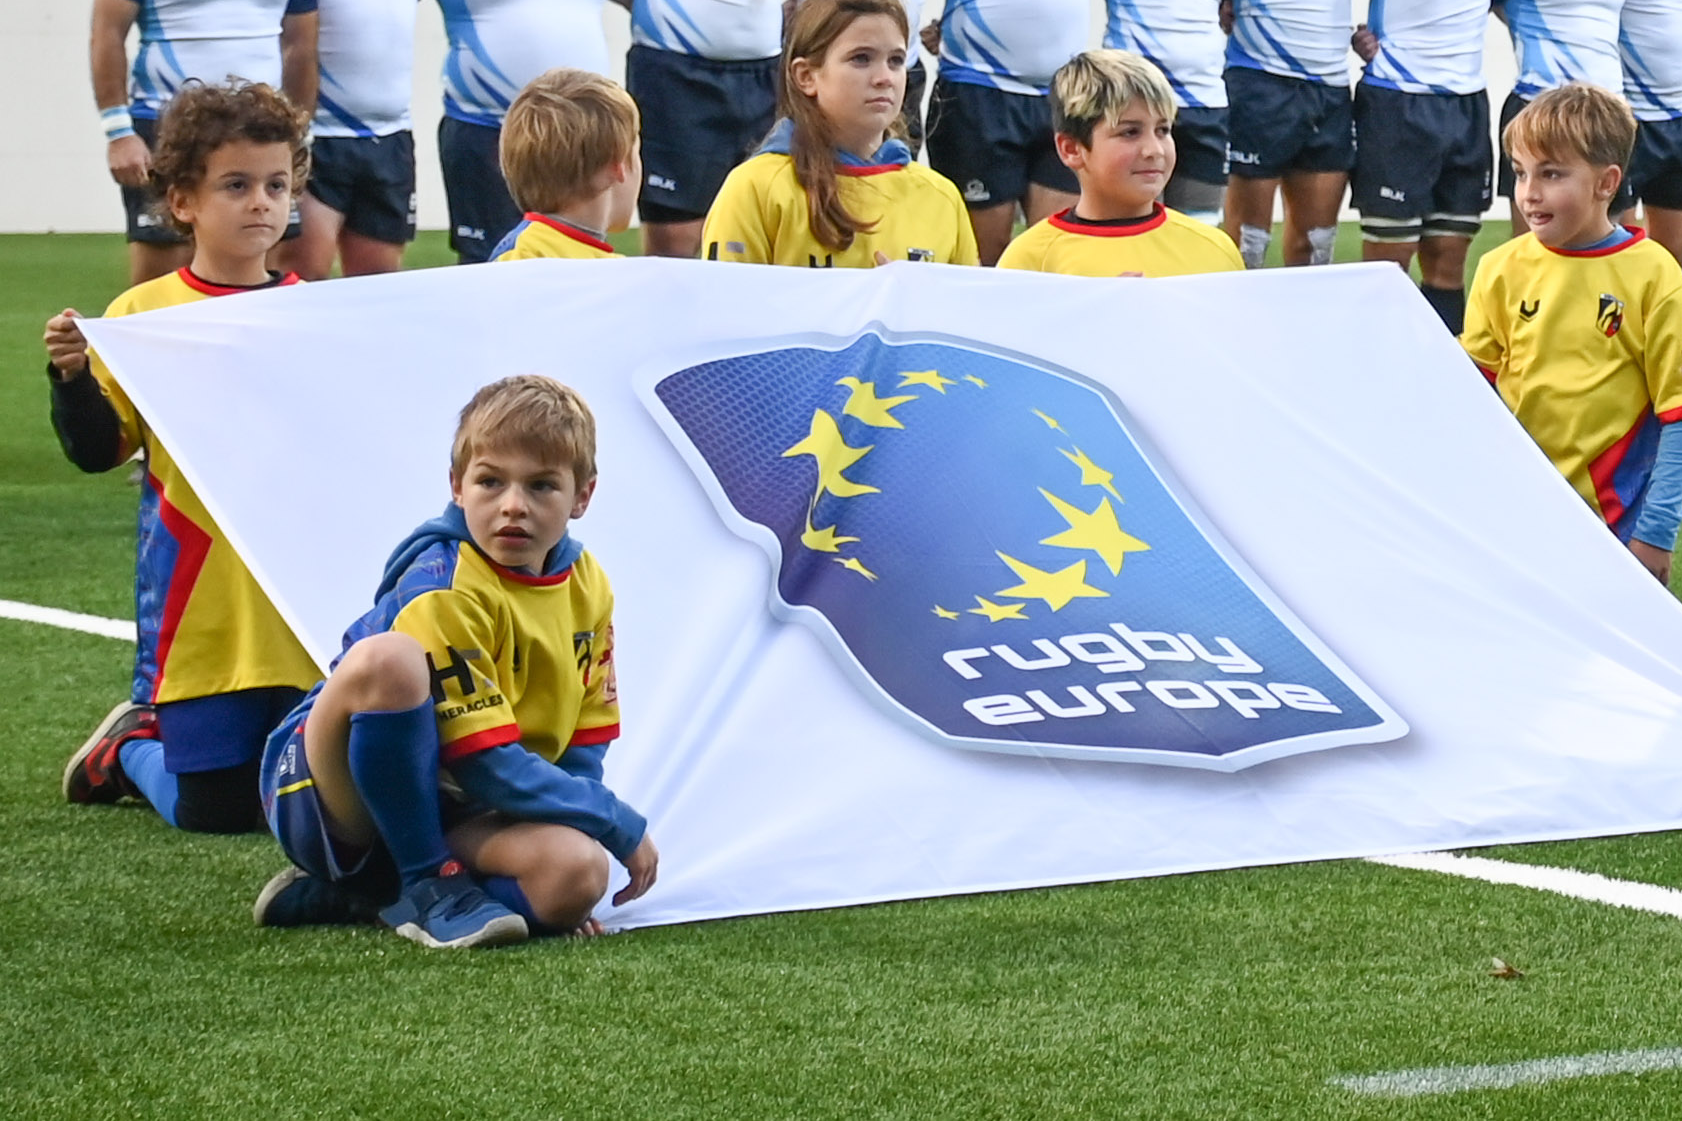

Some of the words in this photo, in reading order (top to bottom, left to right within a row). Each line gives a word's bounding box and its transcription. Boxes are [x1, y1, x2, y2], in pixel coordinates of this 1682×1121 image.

[1380, 186, 1405, 202] BLK
[942, 622, 1265, 682] rugby
[440, 694, 503, 720] HERACLES
[962, 679, 1342, 726] europe
